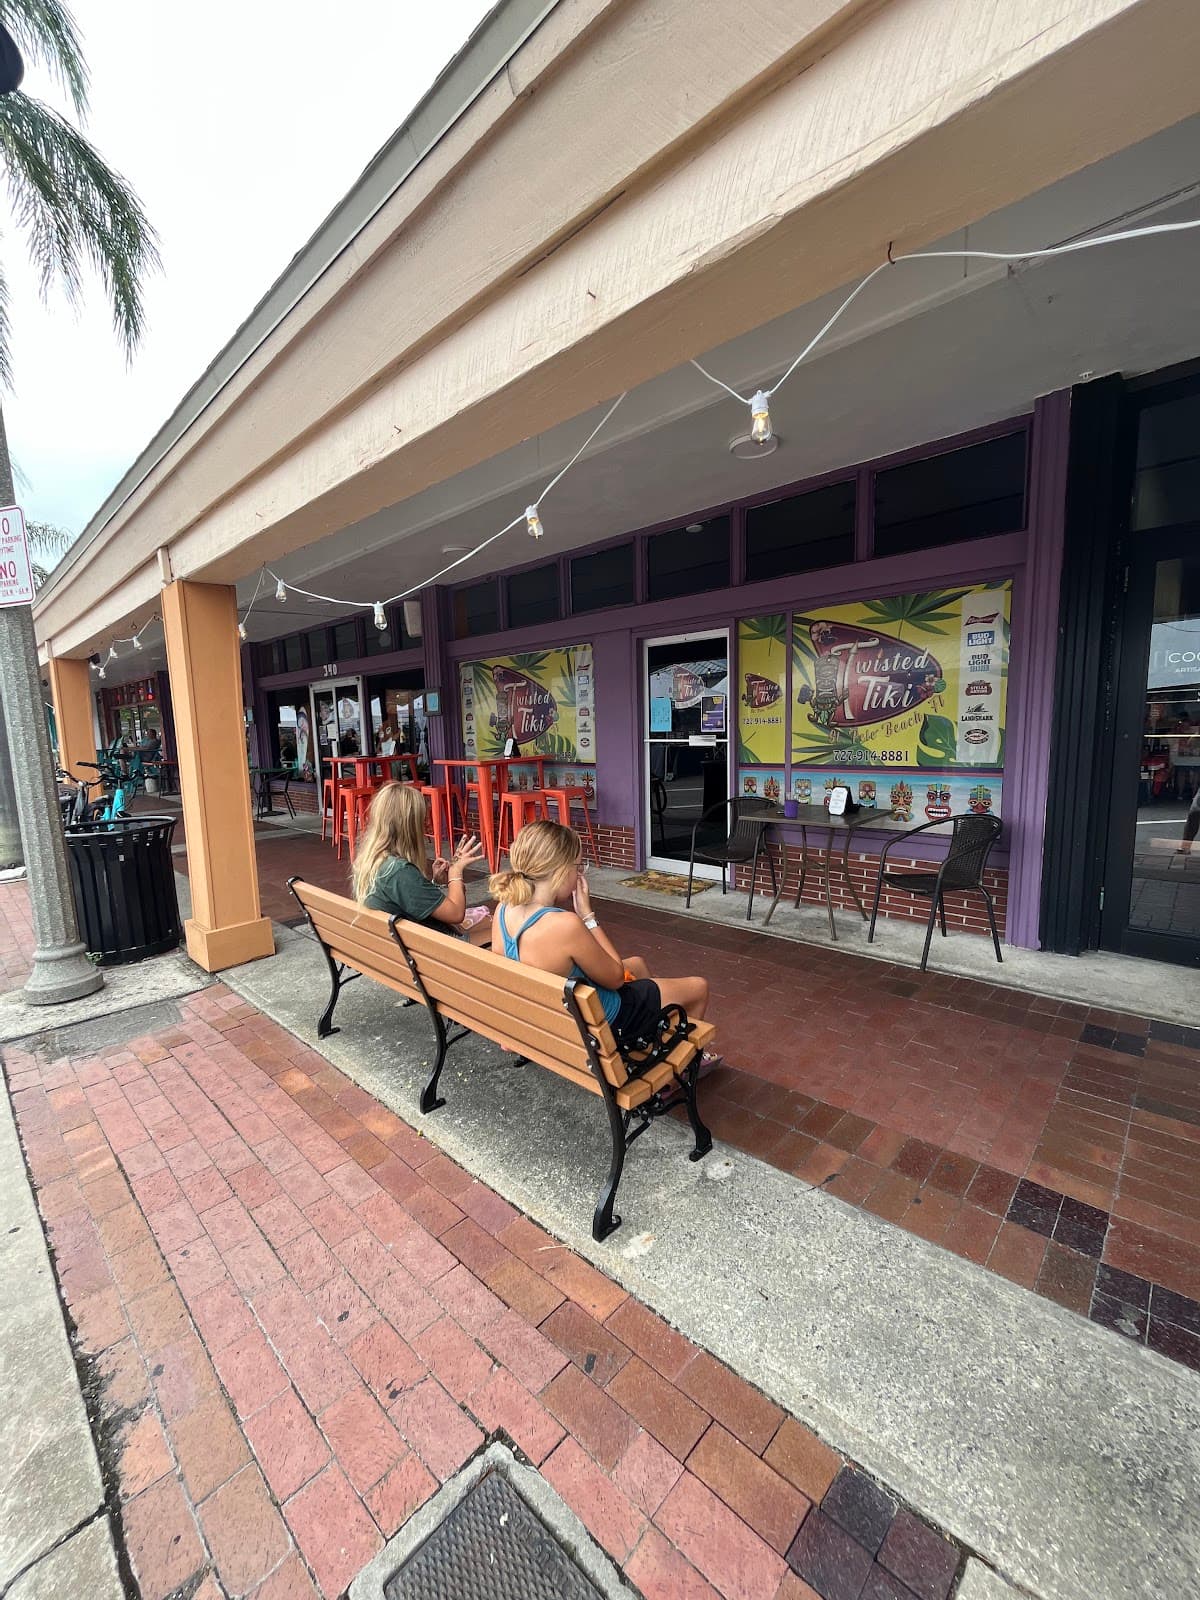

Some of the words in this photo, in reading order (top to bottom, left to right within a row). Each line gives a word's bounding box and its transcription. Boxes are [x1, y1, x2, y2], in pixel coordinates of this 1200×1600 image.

[0, 561, 16, 579] NO
[968, 638, 993, 646] LIGHT
[972, 632, 990, 640] BUD
[1168, 651, 1200, 663] CO
[829, 637, 930, 720] Twisted
[857, 675, 918, 711] Tiki
[517, 707, 545, 734] Tiki
[833, 749, 910, 762] 727-914-8881
